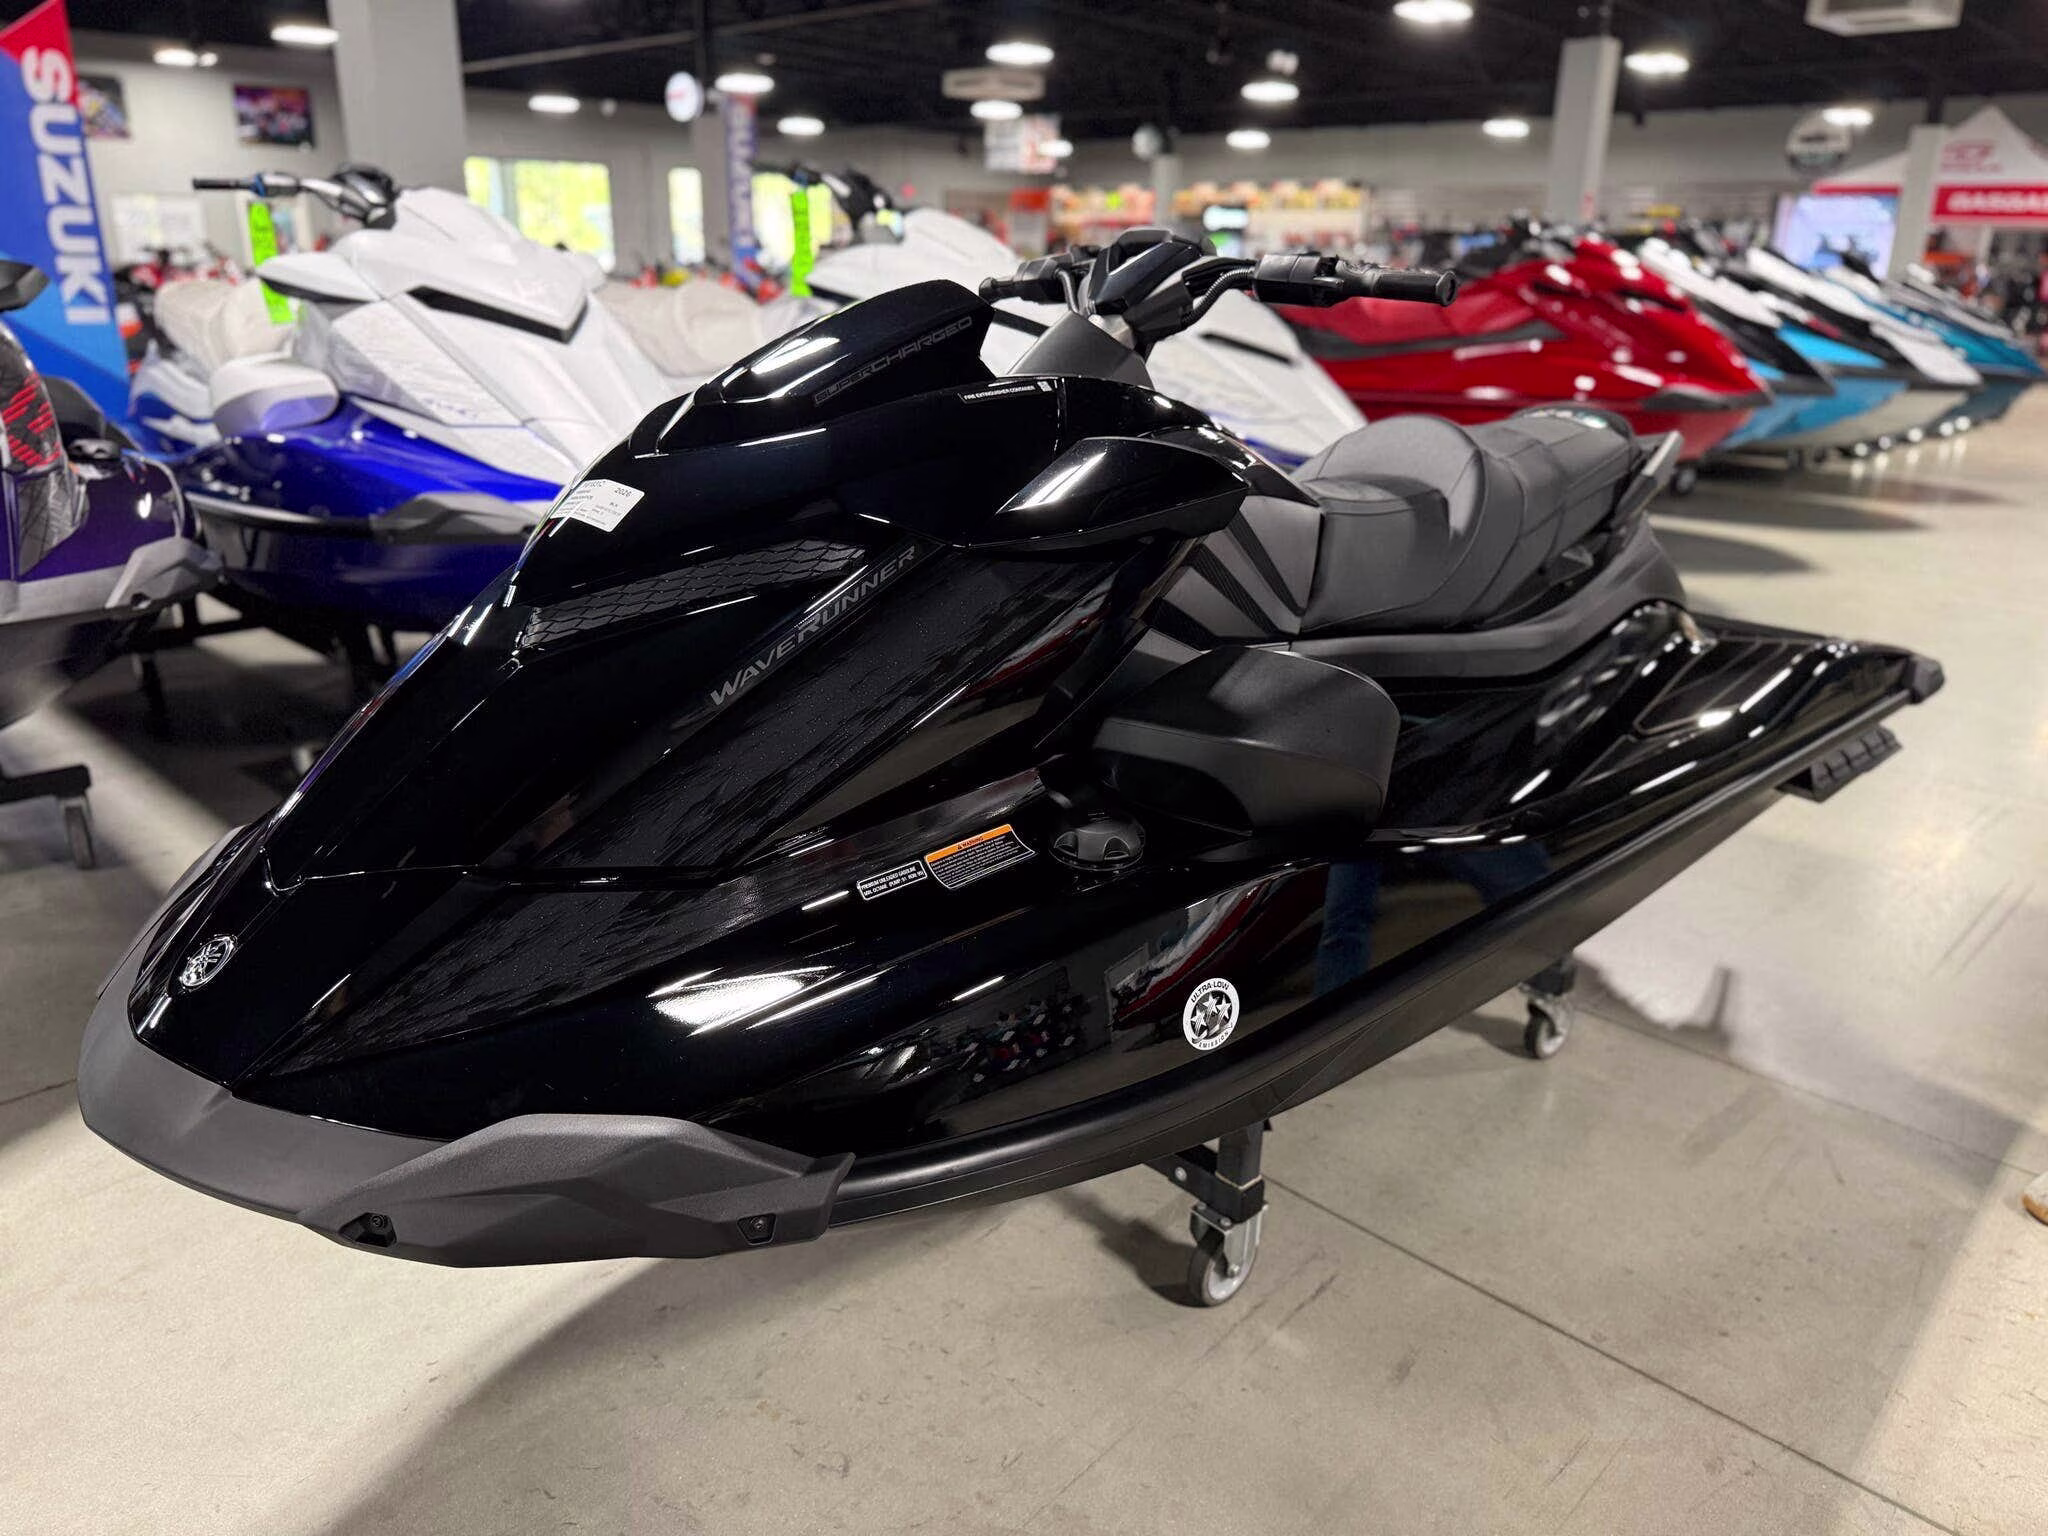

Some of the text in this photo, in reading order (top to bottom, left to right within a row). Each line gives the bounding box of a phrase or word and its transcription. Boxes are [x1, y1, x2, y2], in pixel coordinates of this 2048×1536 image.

[20, 45, 111, 325] SUZUKI
[814, 316, 973, 406] SUPERCHARGED
[614, 487, 632, 497] 2026
[710, 546, 914, 706] WAVERUNNER
[962, 836, 984, 848] WARNING
[1191, 981, 1230, 1003] ULTRA LOW
[1198, 1031, 1229, 1048] EMISSION
